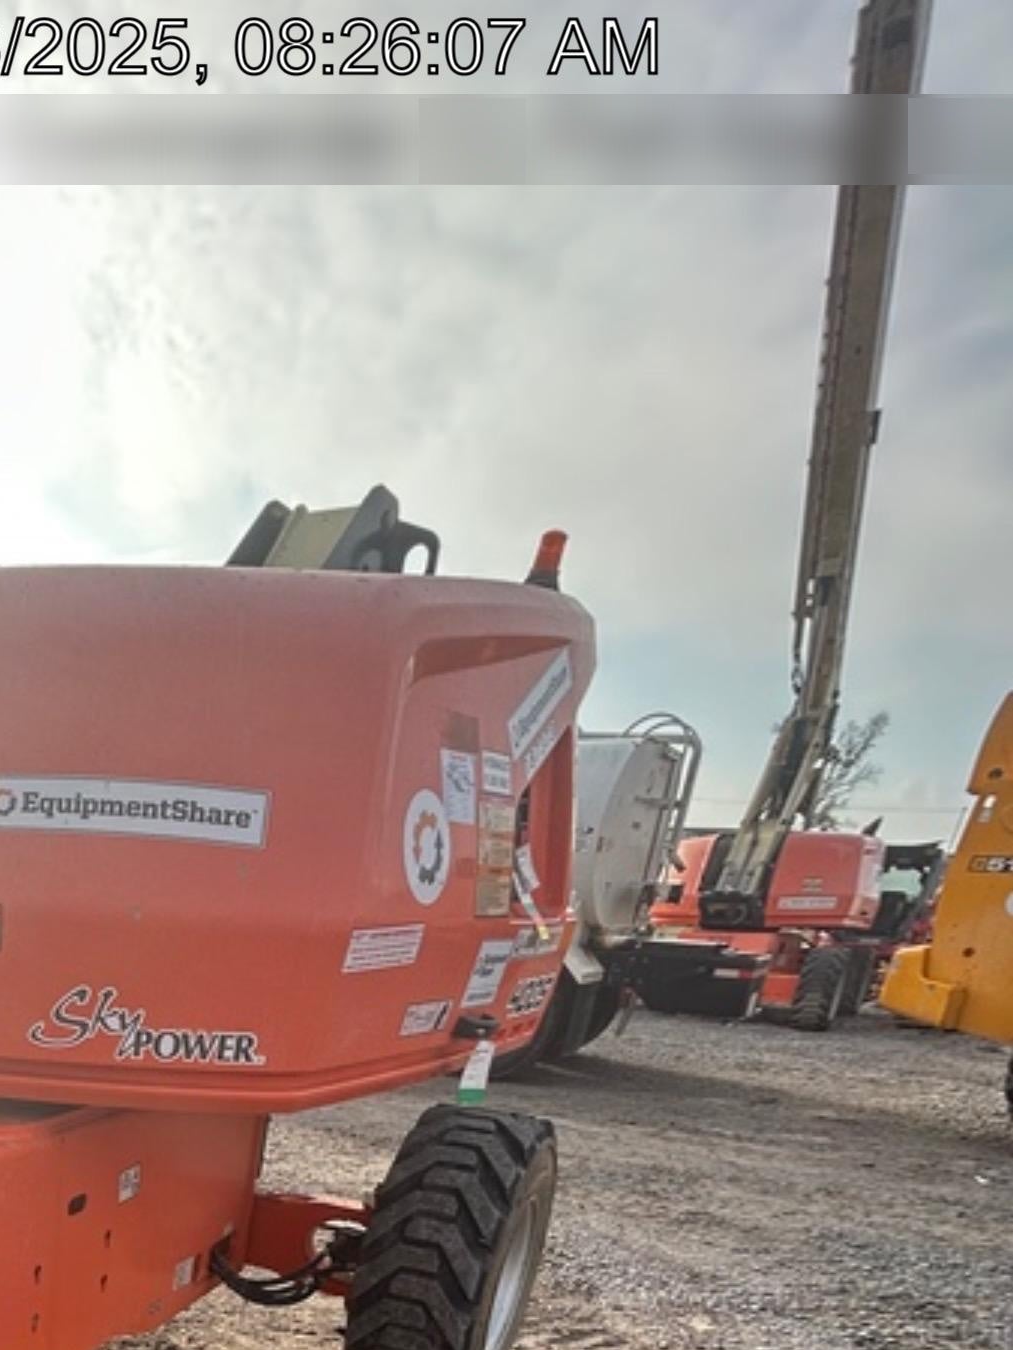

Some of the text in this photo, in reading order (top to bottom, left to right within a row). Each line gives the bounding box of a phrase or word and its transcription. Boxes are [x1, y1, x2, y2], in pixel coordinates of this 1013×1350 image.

[21, 790, 253, 829] EquipmentShare
[28, 985, 256, 1065] Sky POWER
